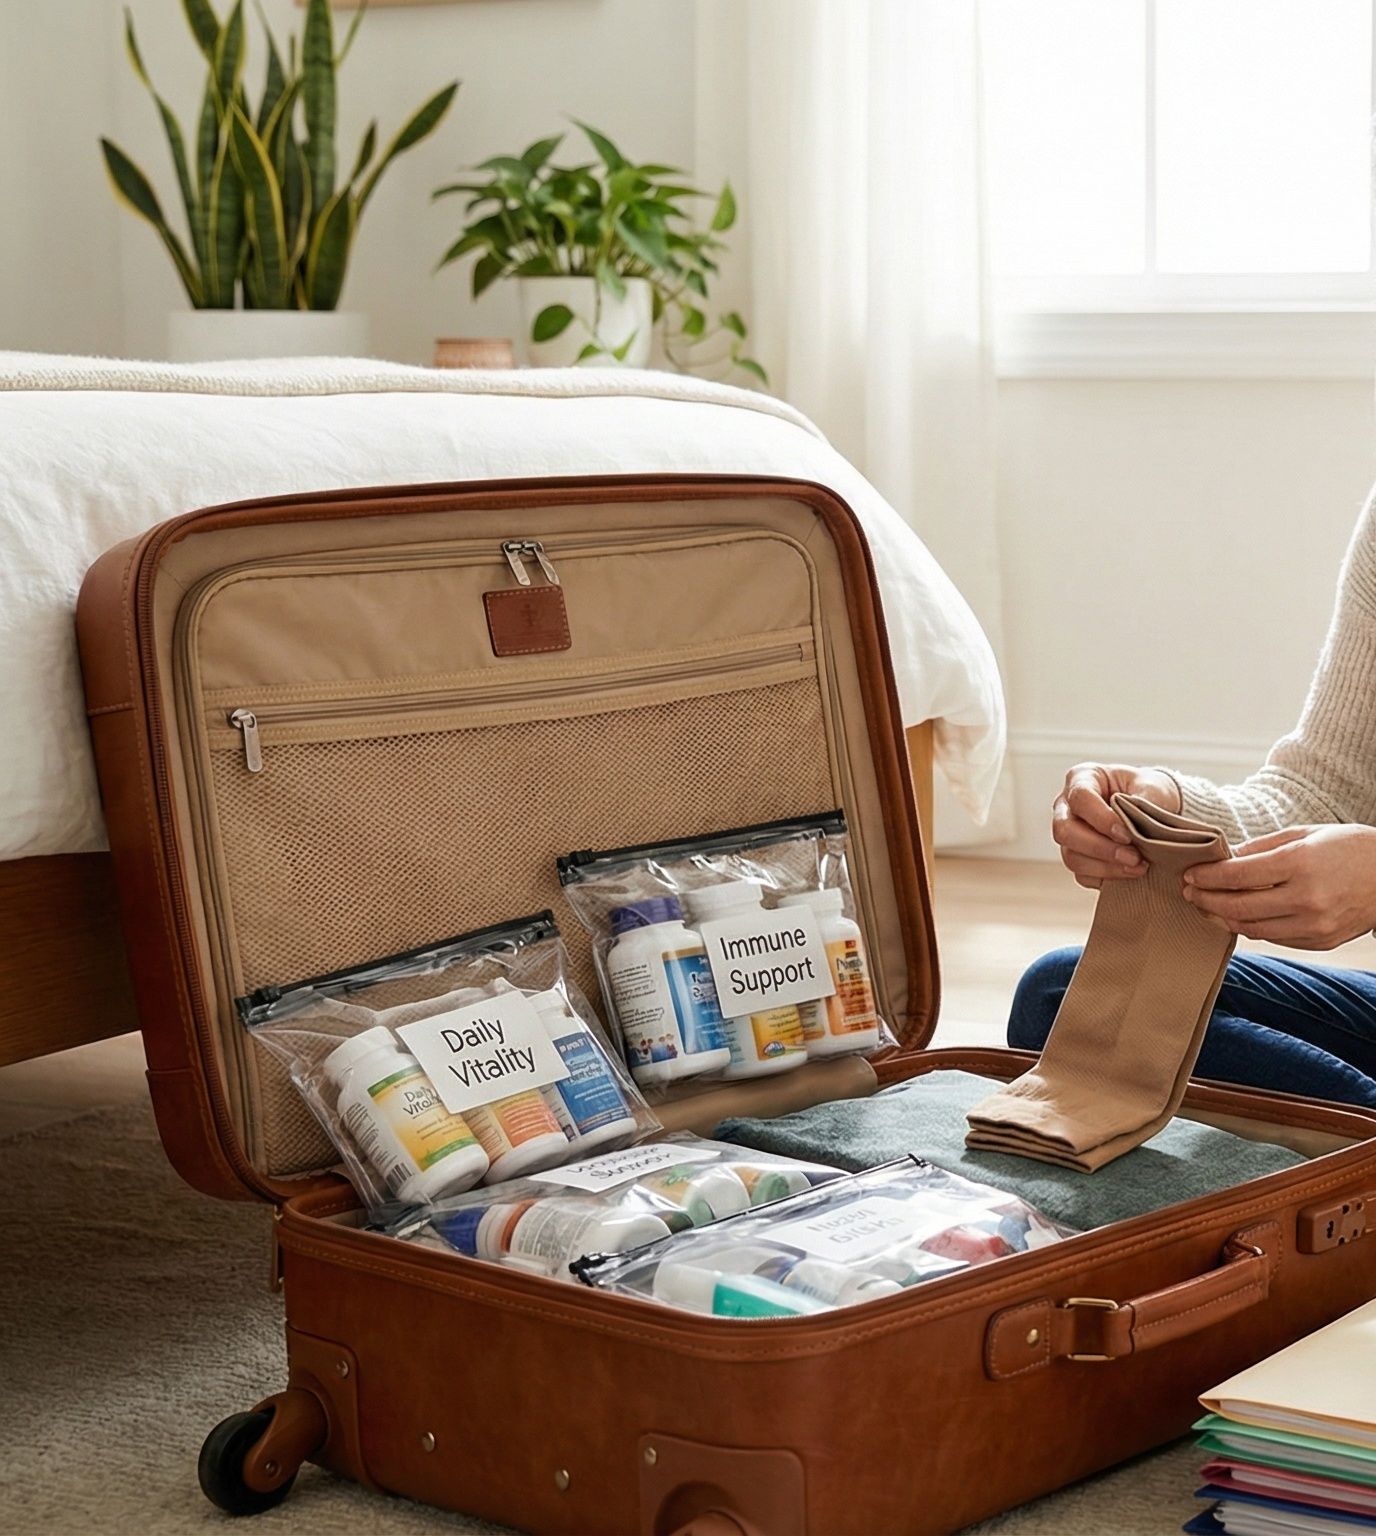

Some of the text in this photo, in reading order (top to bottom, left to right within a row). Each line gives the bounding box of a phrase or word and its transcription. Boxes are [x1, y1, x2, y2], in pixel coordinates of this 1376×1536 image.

[719, 928, 807, 961] Immune
[730, 957, 816, 995] Support
[440, 1018, 505, 1053] Daily
[448, 1046, 536, 1087] Vitality
